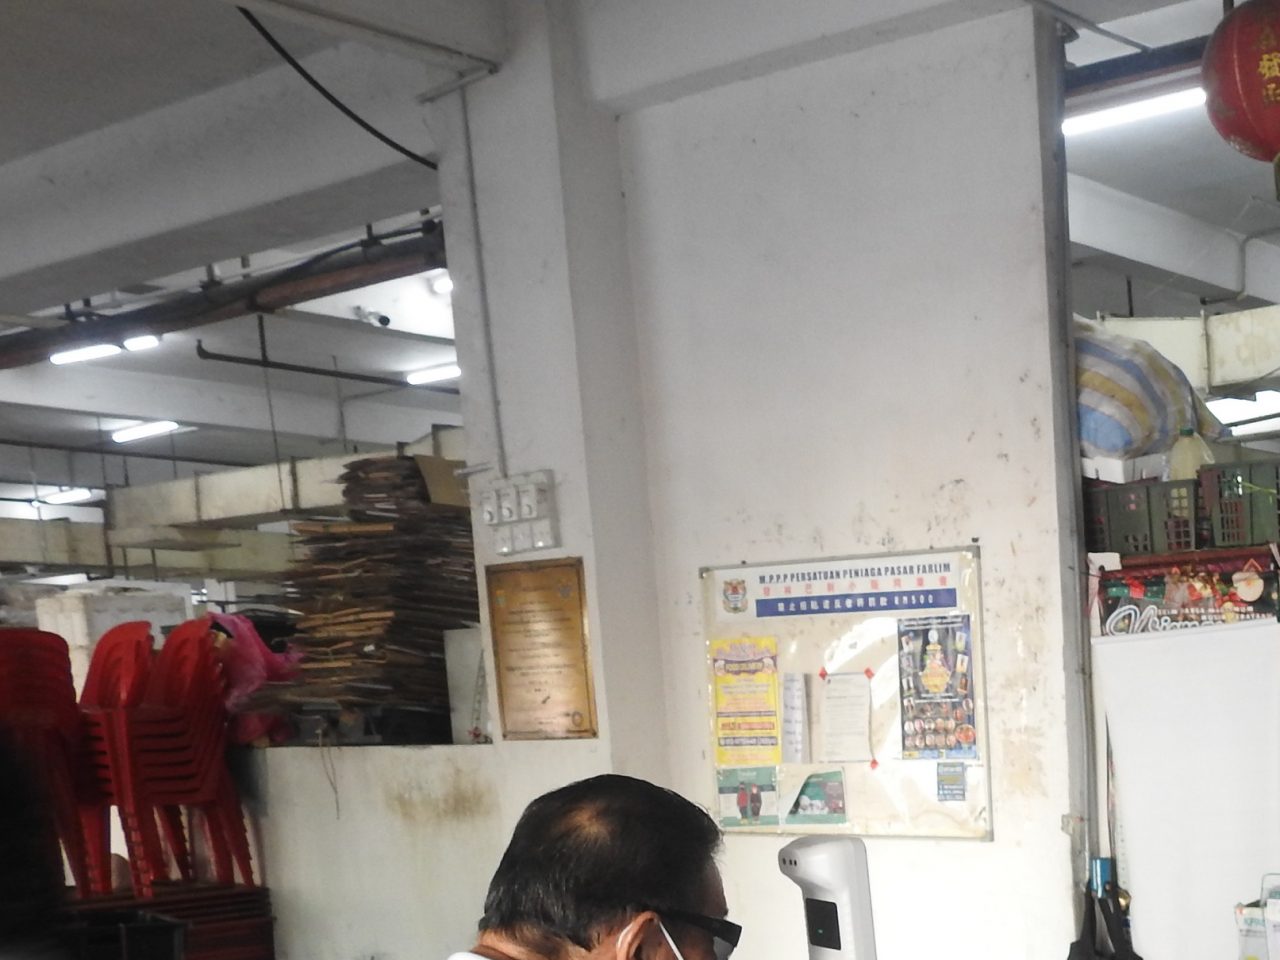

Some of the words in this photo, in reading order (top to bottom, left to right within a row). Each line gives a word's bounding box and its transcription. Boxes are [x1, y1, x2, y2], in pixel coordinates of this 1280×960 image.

[790, 570, 841, 583] PERSATUAN
[843, 567, 882, 579] PENIAGA
[884, 565, 914, 576] PASAR
[916, 563, 951, 574] FARLIM
